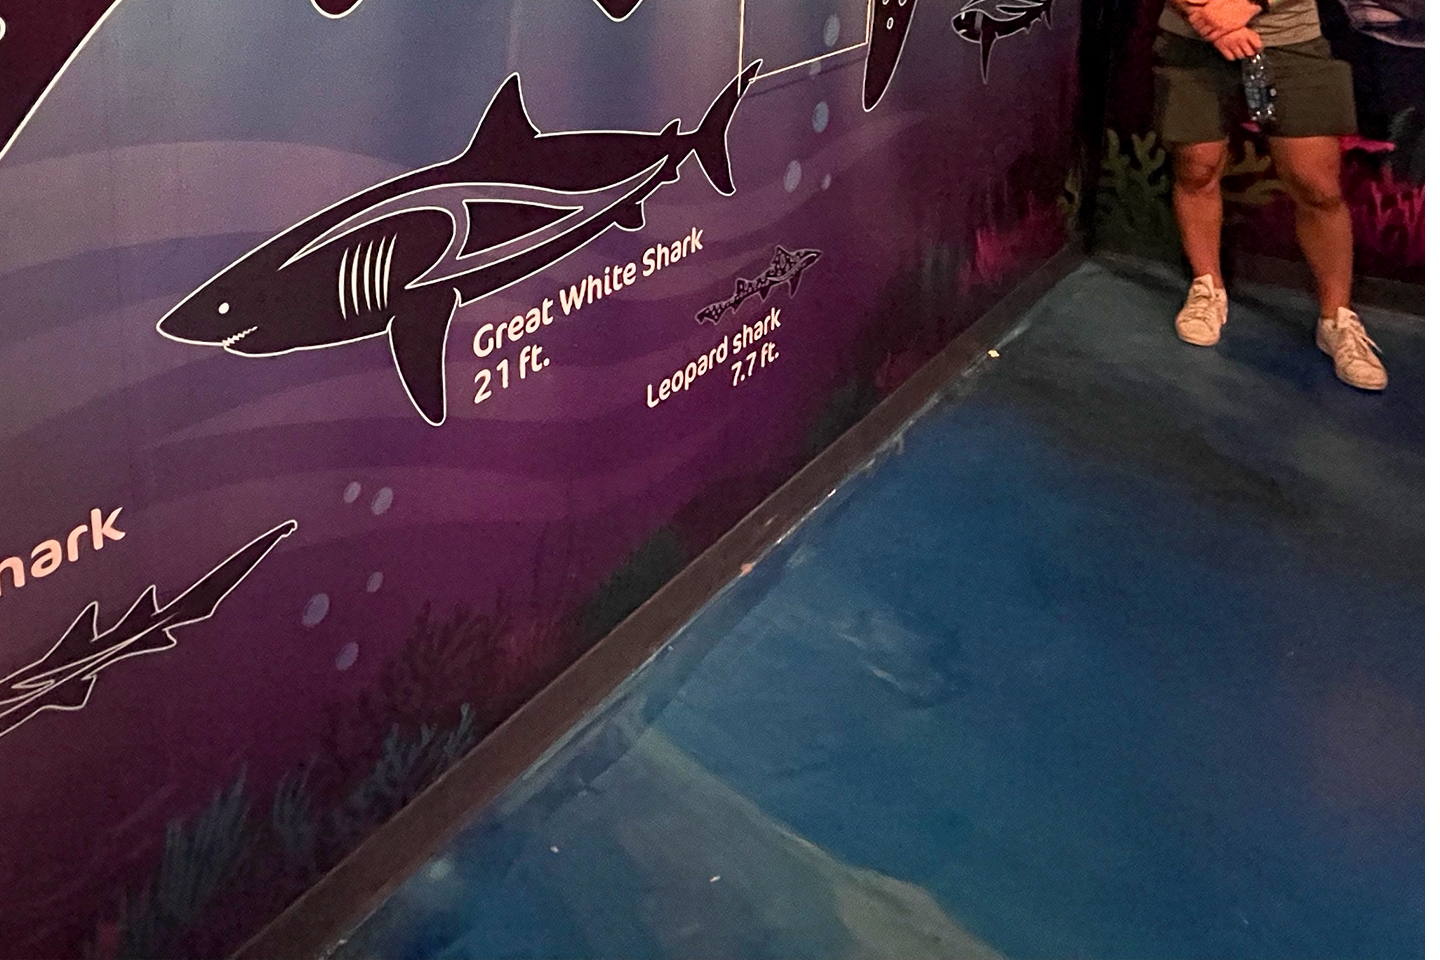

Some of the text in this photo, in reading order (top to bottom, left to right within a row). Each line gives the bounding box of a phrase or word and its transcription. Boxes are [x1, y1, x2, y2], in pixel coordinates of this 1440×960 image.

[473, 227, 704, 357] Great White Shark
[473, 344, 550, 404] 21 ft.
[647, 308, 781, 408] Leopard shark
[731, 341, 780, 387] 7.7 ft.
